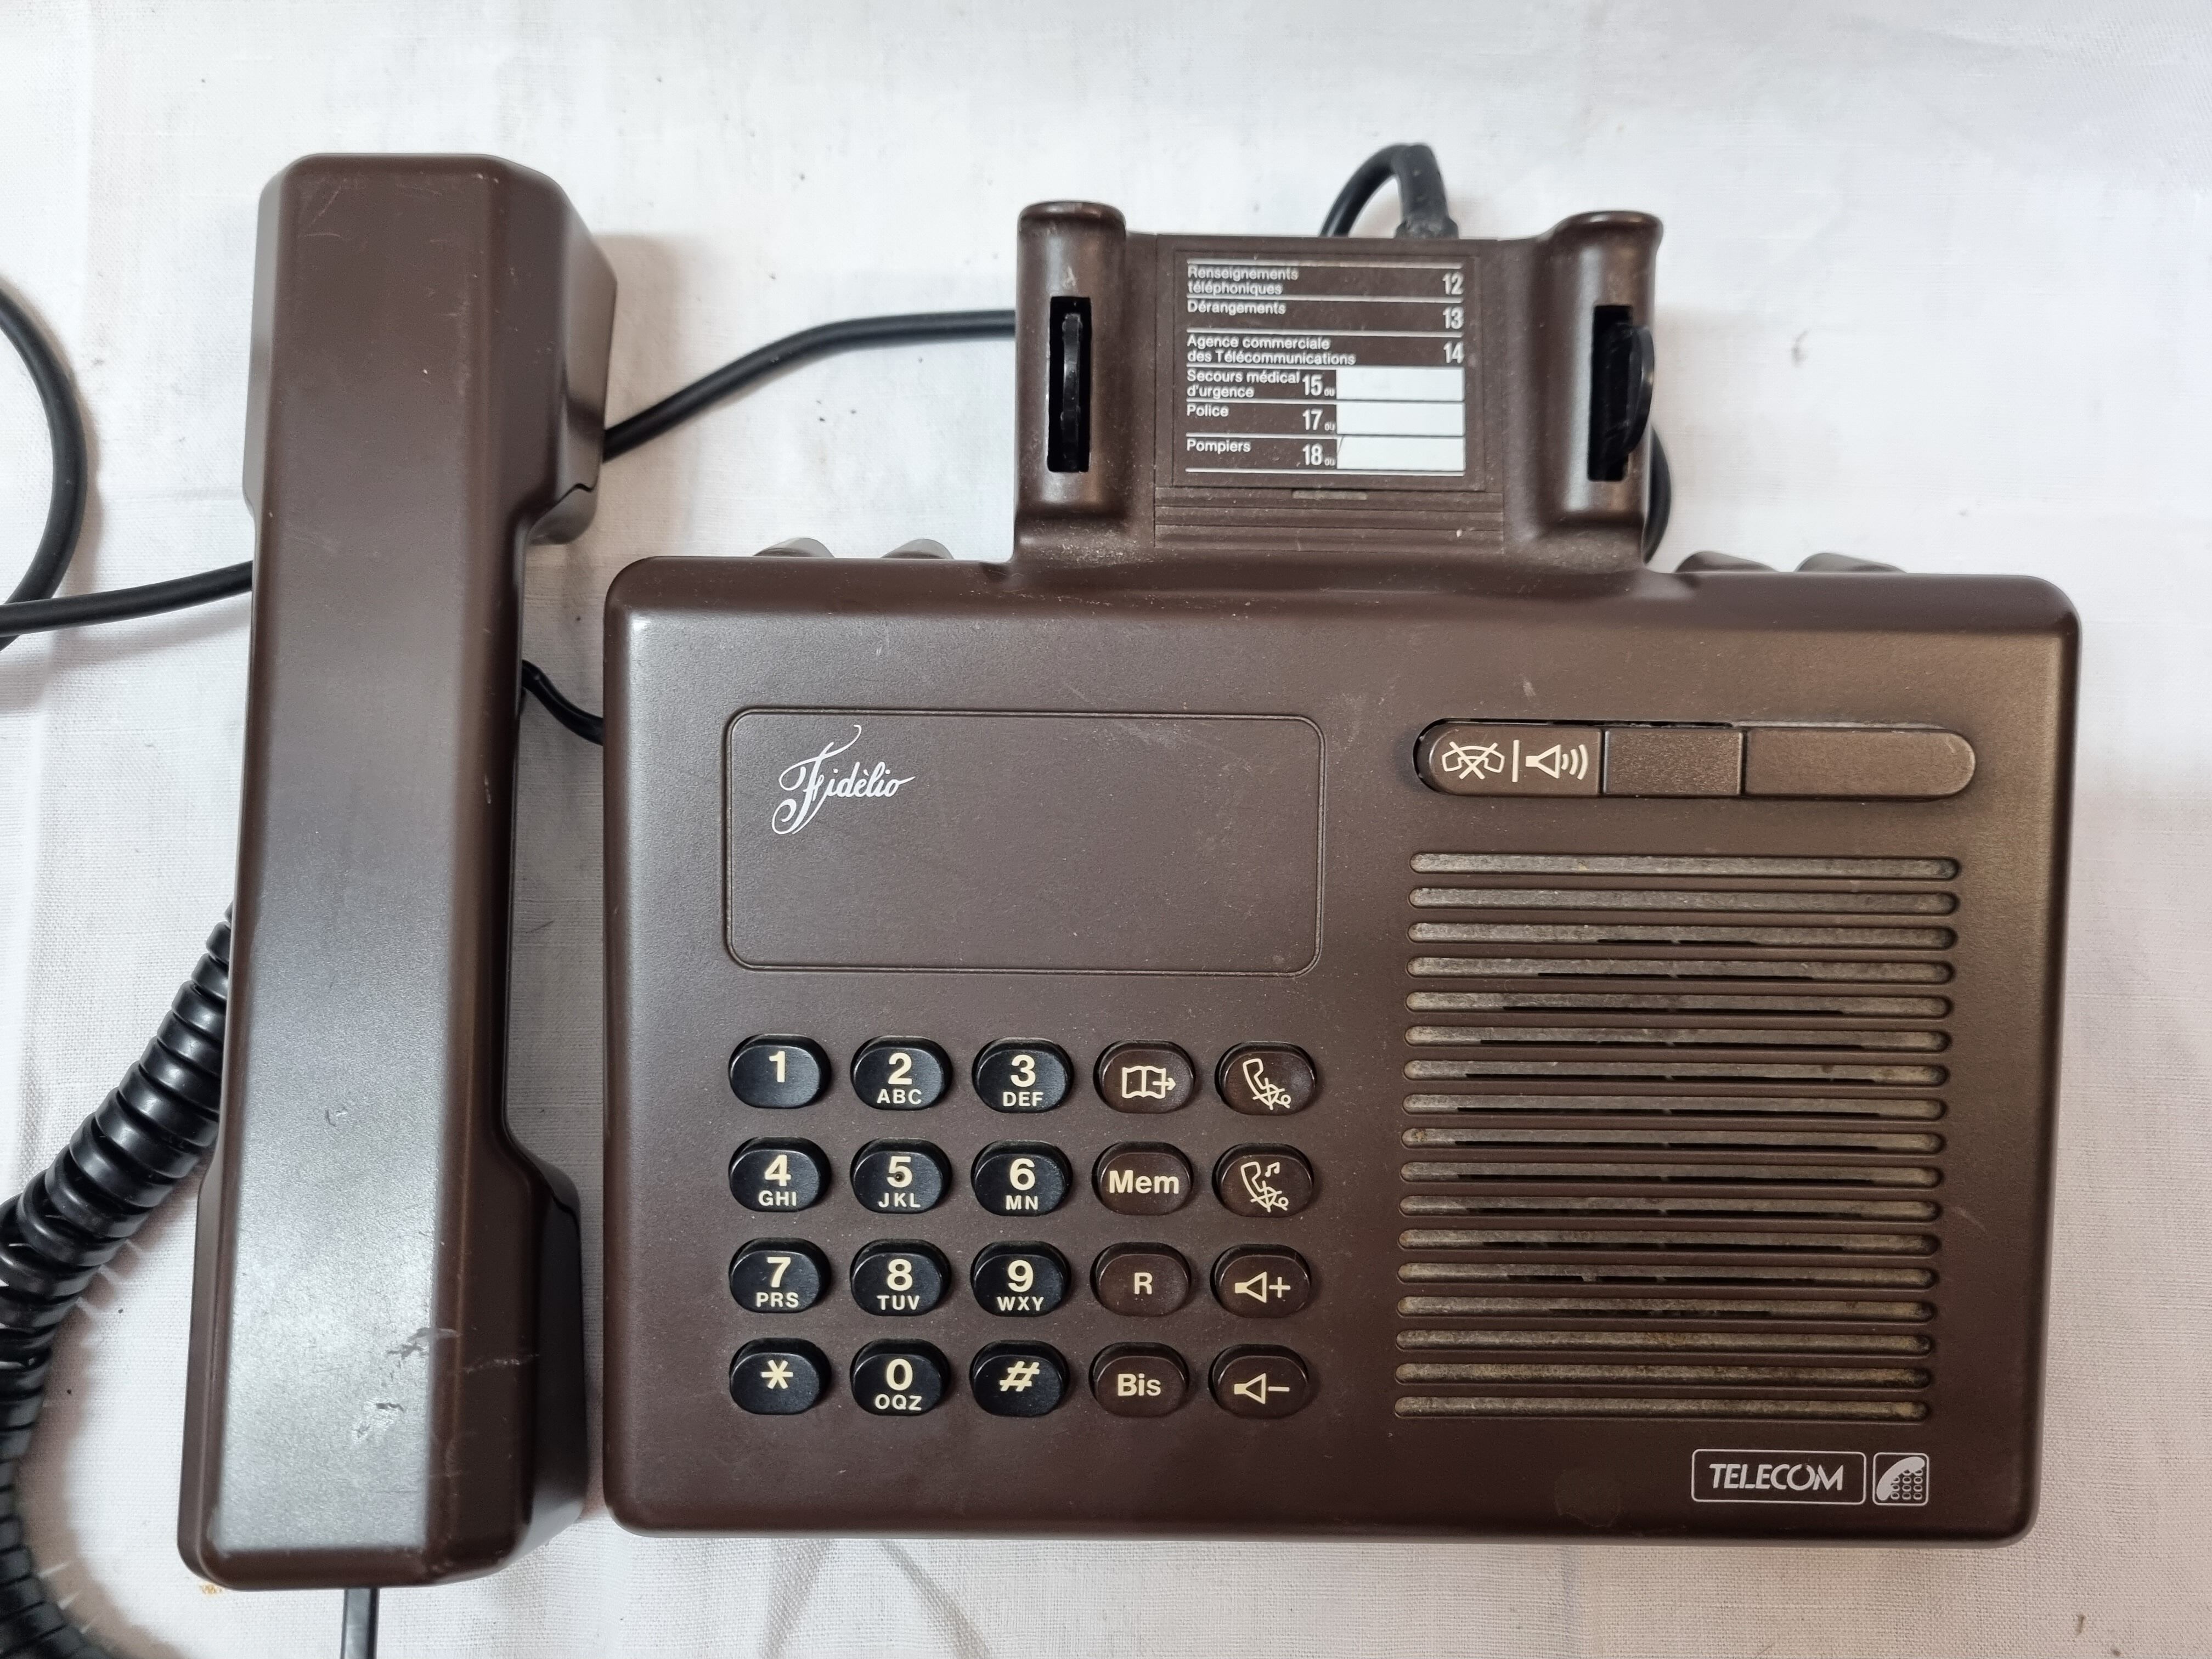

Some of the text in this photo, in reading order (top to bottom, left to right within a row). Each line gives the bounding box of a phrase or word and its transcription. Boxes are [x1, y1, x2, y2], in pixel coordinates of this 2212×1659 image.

[1188, 265, 1299, 281] Renseignements
[1442, 273, 1464, 295] 12
[1188, 281, 1283, 296] téléphoniques
[1187, 300, 1286, 315] Dérangements
[1442, 306, 1464, 330] 13
[1187, 334, 1331, 349] Agence commerciale
[1443, 341, 1464, 363] 14
[1187, 350, 1356, 365] des Télécommunications
[1187, 369, 1300, 383] Secours médical
[1302, 374, 1335, 396] 15 ou
[1187, 384, 1255, 399] d'urgence
[1187, 403, 1229, 416] Police
[1302, 409, 1336, 431] 17 ou
[1187, 438, 1251, 454] Pompiers
[1302, 444, 1335, 466] 18 ou
[769, 1051, 786, 1083] 1
[888, 1052, 912, 1085] 2
[1011, 1054, 1036, 1087] 3
[877, 1090, 922, 1104] ABC
[1003, 1092, 1044, 1107] DEF
[765, 1155, 791, 1187] 4
[887, 1156, 912, 1188] 5
[1009, 1158, 1035, 1191] 6
[1109, 1170, 1179, 1194] Mem
[758, 1191, 797, 1206] GHI
[878, 1193, 921, 1208] JKL
[1006, 1195, 1039, 1210] MN
[767, 1257, 791, 1288] 7
[887, 1259, 912, 1291] 8
[1008, 1260, 1034, 1293] 9
[1134, 1272, 1152, 1295] R
[756, 1293, 799, 1308] PRS
[877, 1295, 920, 1310] TUV
[997, 1296, 1044, 1311] WXY
[886, 1359, 913, 1391] 0
[1117, 1373, 1161, 1397] Bis
[875, 1395, 922, 1410] OQZ
[1709, 1463, 1843, 1491] TELECOM
